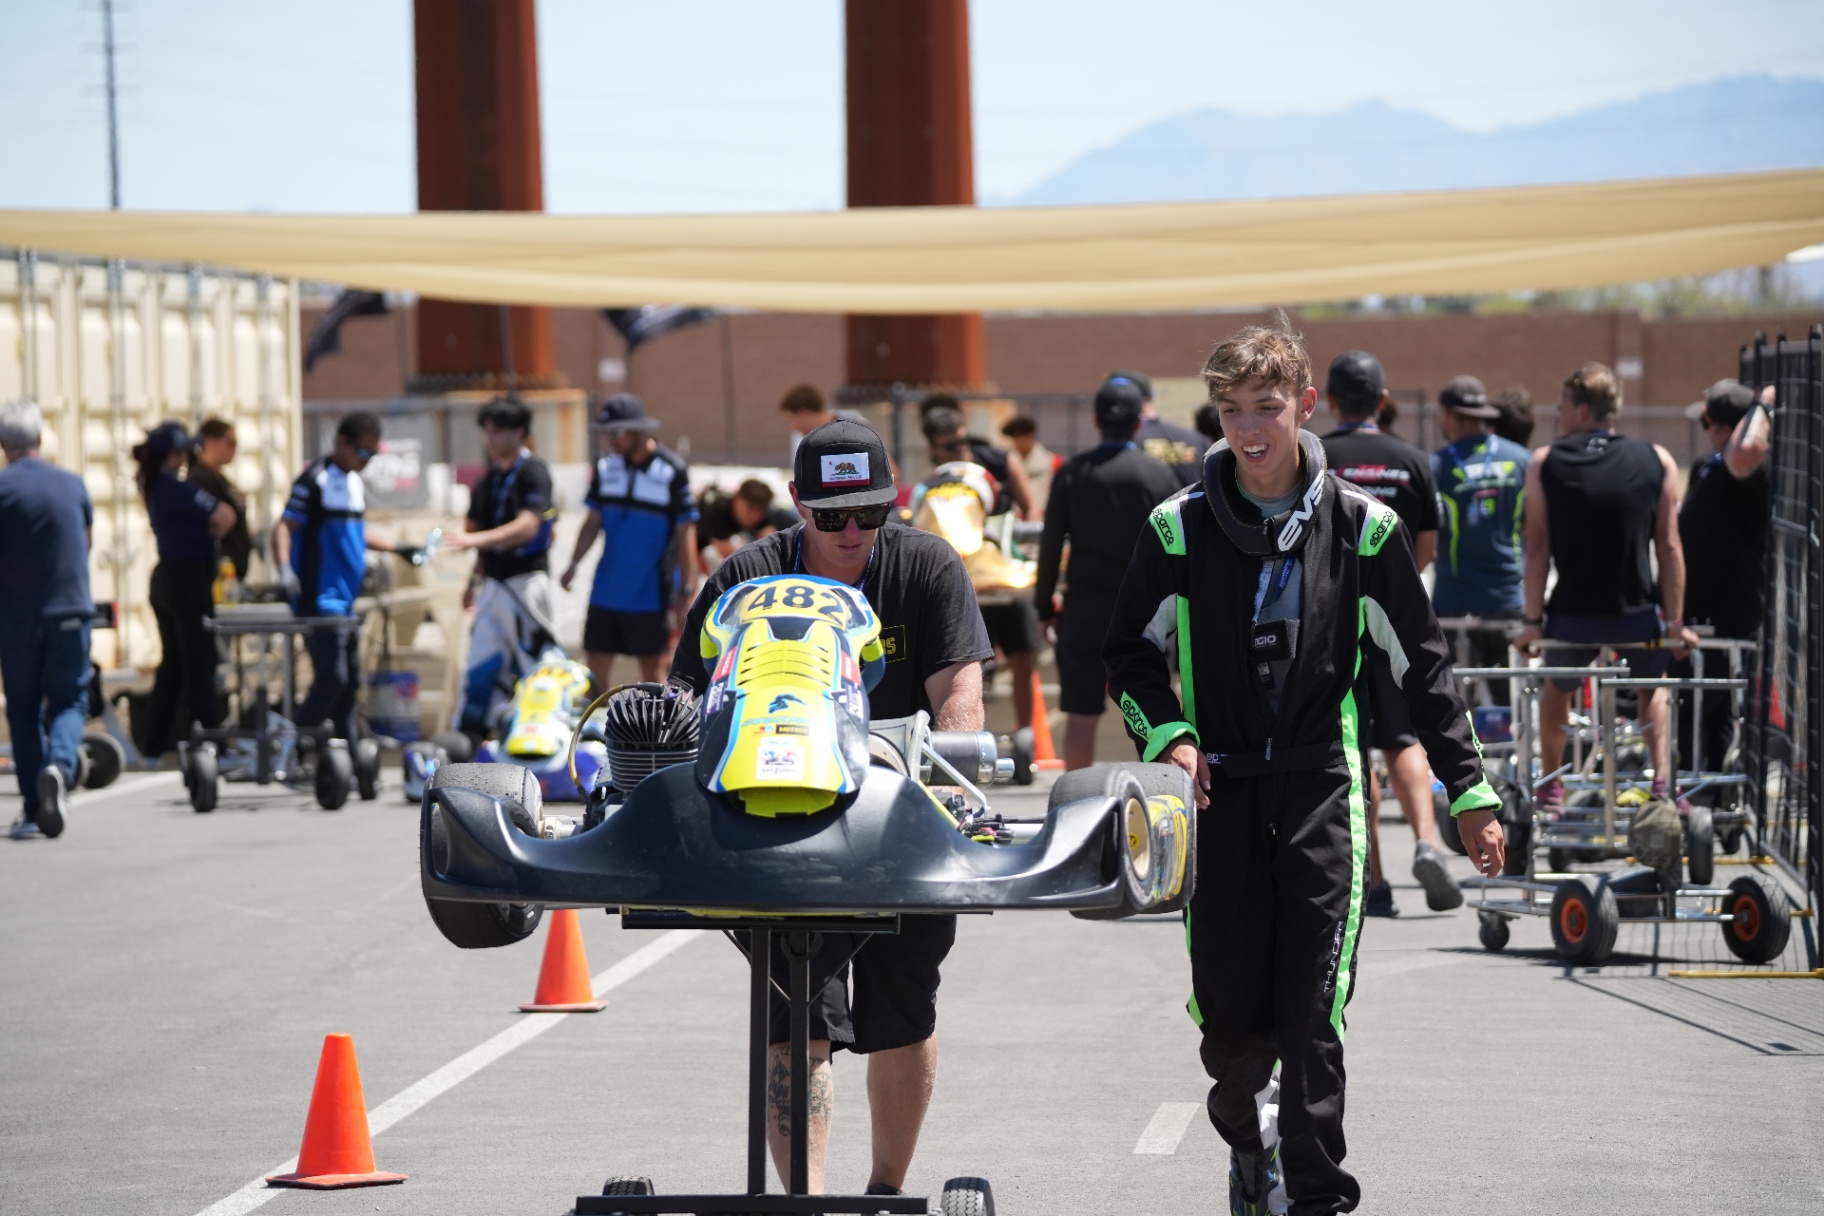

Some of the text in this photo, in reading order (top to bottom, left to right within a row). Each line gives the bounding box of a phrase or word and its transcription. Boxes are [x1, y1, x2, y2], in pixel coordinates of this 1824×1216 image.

[1154, 508, 1174, 546] sparco
[1370, 511, 1394, 547] sparco
[748, 586, 844, 626] 482
[1122, 700, 1148, 738] sparco
[1323, 920, 1344, 993] THUNDER
